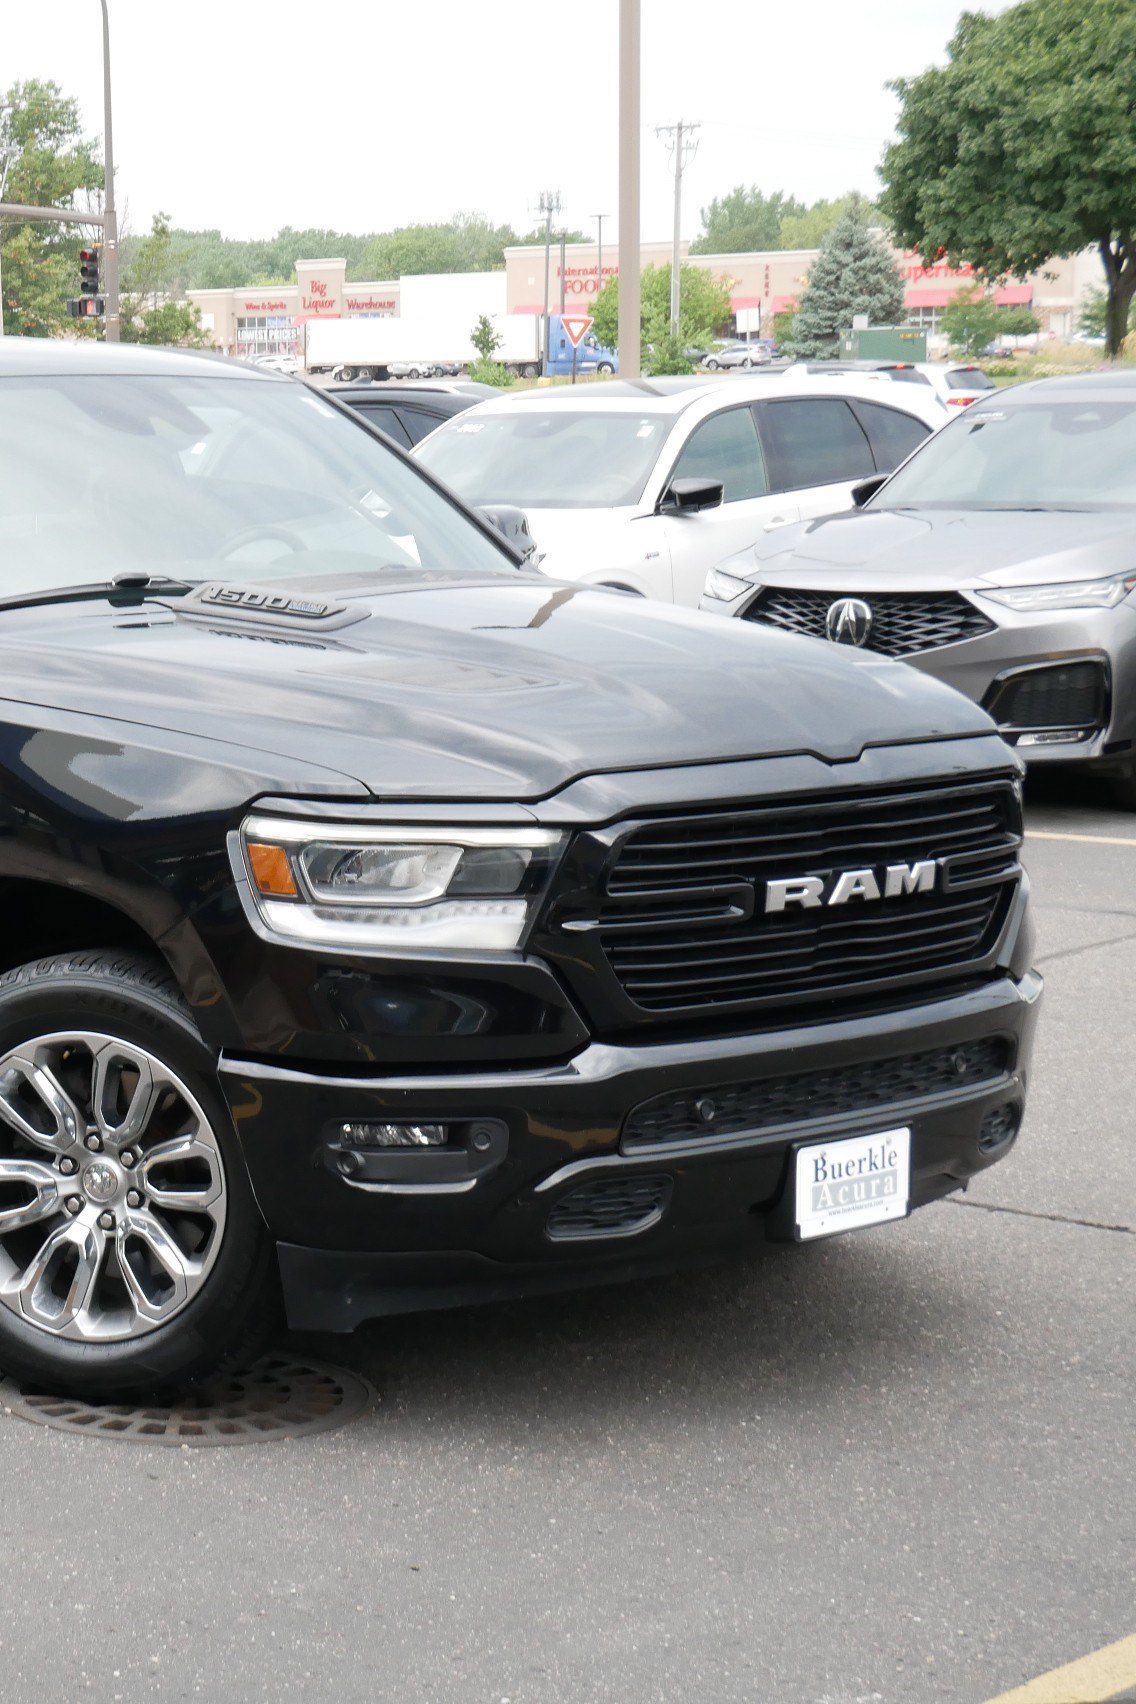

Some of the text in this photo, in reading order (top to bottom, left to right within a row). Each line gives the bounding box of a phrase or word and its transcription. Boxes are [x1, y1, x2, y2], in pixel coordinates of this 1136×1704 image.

[310, 280, 328, 297] Big
[303, 296, 336, 313] Liquor
[347, 295, 396, 311] Warehouse
[237, 328, 297, 340] LOWEST PRICES
[209, 587, 289, 609] 1500
[765, 860, 936, 913] RAM
[813, 1145, 898, 1183] Buerkle
[816, 1174, 895, 1209] Acura
